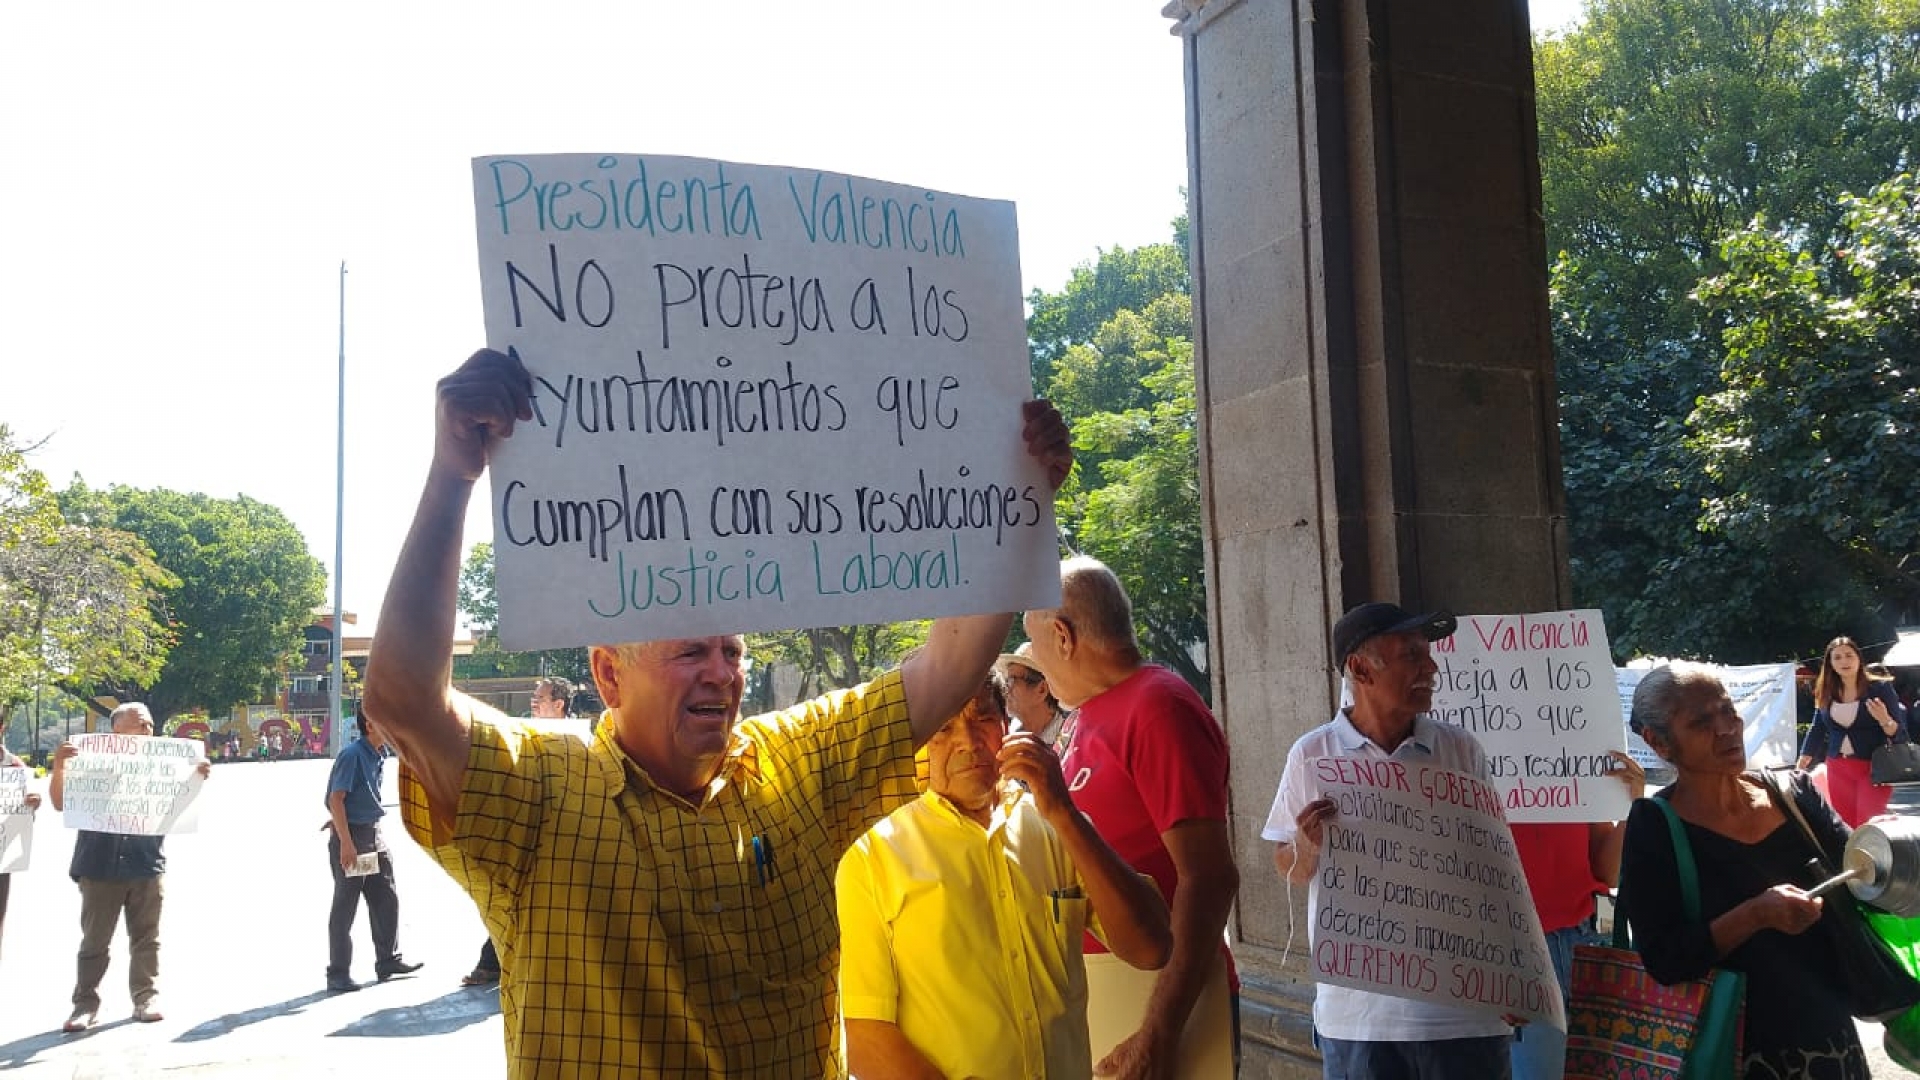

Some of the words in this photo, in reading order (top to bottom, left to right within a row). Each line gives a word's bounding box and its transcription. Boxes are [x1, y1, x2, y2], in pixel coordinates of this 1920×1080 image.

[490, 157, 762, 241] Presidenta
[789, 175, 965, 258] Valencia
[505, 244, 614, 328] NO
[654, 254, 835, 348] proteja
[851, 278, 886, 335] a
[907, 266, 969, 342] los
[877, 374, 960, 446] que
[502, 464, 691, 562] Cumplan
[710, 485, 771, 538] con
[787, 486, 843, 534] sus
[856, 466, 1040, 546] resoluciones
[588, 547, 784, 618] Justicia
[812, 534, 970, 596] Laboral.
[1471, 612, 1590, 652] Valencia
[1510, 666, 1528, 692] a
[1546, 657, 1591, 691] los
[1537, 704, 1587, 735] que
[1507, 778, 1588, 809] aboral.
[1328, 824, 1366, 858] para
[1374, 835, 1402, 869] que
[1409, 846, 1429, 871] se
[1431, 815, 1450, 837] su
[1323, 863, 1346, 890] de
[1354, 864, 1379, 898] las
[1383, 881, 1472, 919] pensiones
[1479, 896, 1498, 923] de
[1319, 900, 1406, 944] decretos
[1415, 918, 1505, 968] impugnados
[1316, 940, 1438, 994] QUEREMOS
